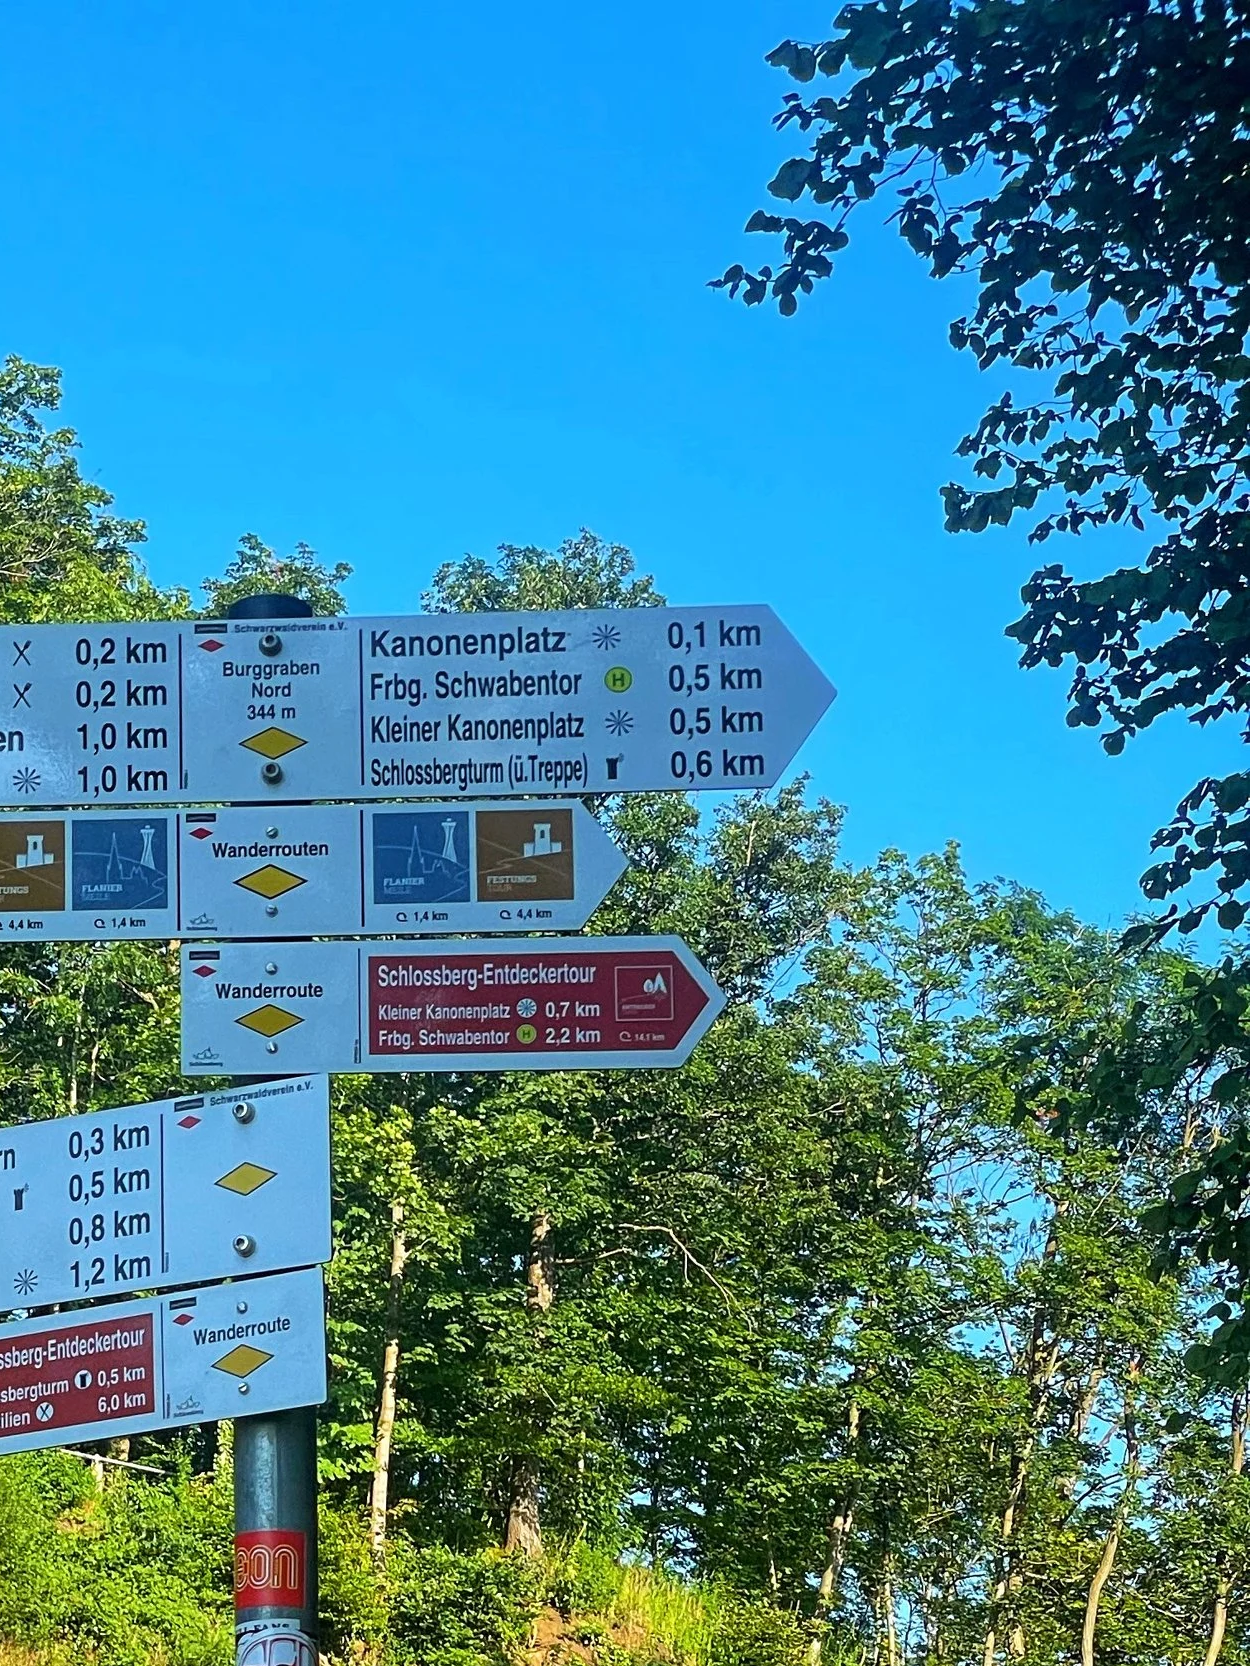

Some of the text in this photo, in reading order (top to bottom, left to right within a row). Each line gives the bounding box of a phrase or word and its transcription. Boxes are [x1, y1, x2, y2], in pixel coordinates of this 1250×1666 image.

[370, 619, 761, 661] Kanonenplatz 0,1 km
[76, 638, 115, 671] 0,2
[126, 637, 167, 664] km
[222, 660, 320, 680] Burggraben
[76, 680, 116, 713] 0,2
[126, 679, 167, 706] km
[251, 682, 292, 699] Nord
[370, 673, 428, 707] Frbg.
[435, 669, 582, 699] Schwabentor
[668, 664, 710, 697] 0,5
[720, 662, 762, 690] km
[247, 704, 296, 720] 344 m
[77, 723, 116, 755] 1,0
[126, 722, 167, 749] km
[371, 706, 764, 746] Kleiner Kanonenplatz 0,5 km
[77, 765, 117, 798] 1,0
[127, 764, 168, 792] km
[371, 757, 504, 792] Schlossbergturm
[670, 750, 712, 783] 0,6
[722, 749, 765, 776] km
[212, 842, 329, 858] Wanderrouten
[8, 919, 43, 931] 4,4 km
[111, 917, 146, 929] 1,4 km
[414, 910, 448, 924] 1,4 km
[517, 908, 552, 920] 4,4 km
[378, 963, 597, 991] Schlossberg-Entdeckertour
[215, 982, 323, 999] Wanderroute
[378, 1001, 600, 1023] Kleiner Kanonenplatz 0,7 km
[379, 1030, 414, 1050] Frbg.
[419, 1029, 510, 1046] Schwabentor
[545, 1027, 570, 1046] 2,2
[576, 1027, 601, 1043] km
[210, 1085, 294, 1107] Schwarzwaldverein
[69, 1131, 104, 1163] 0,3
[113, 1123, 150, 1152] km
[69, 1173, 105, 1206] 0,5
[113, 1167, 150, 1195] km
[69, 1217, 105, 1250] 0,8
[114, 1210, 151, 1238] km
[70, 1260, 105, 1293] 1,2
[114, 1254, 151, 1281] km
[193, 1316, 291, 1346] Wanderroute
[97, 1370, 119, 1389] 0,5
[123, 1366, 146, 1382] km
[98, 1396, 120, 1415] 6,0
[124, 1391, 146, 1408] km
